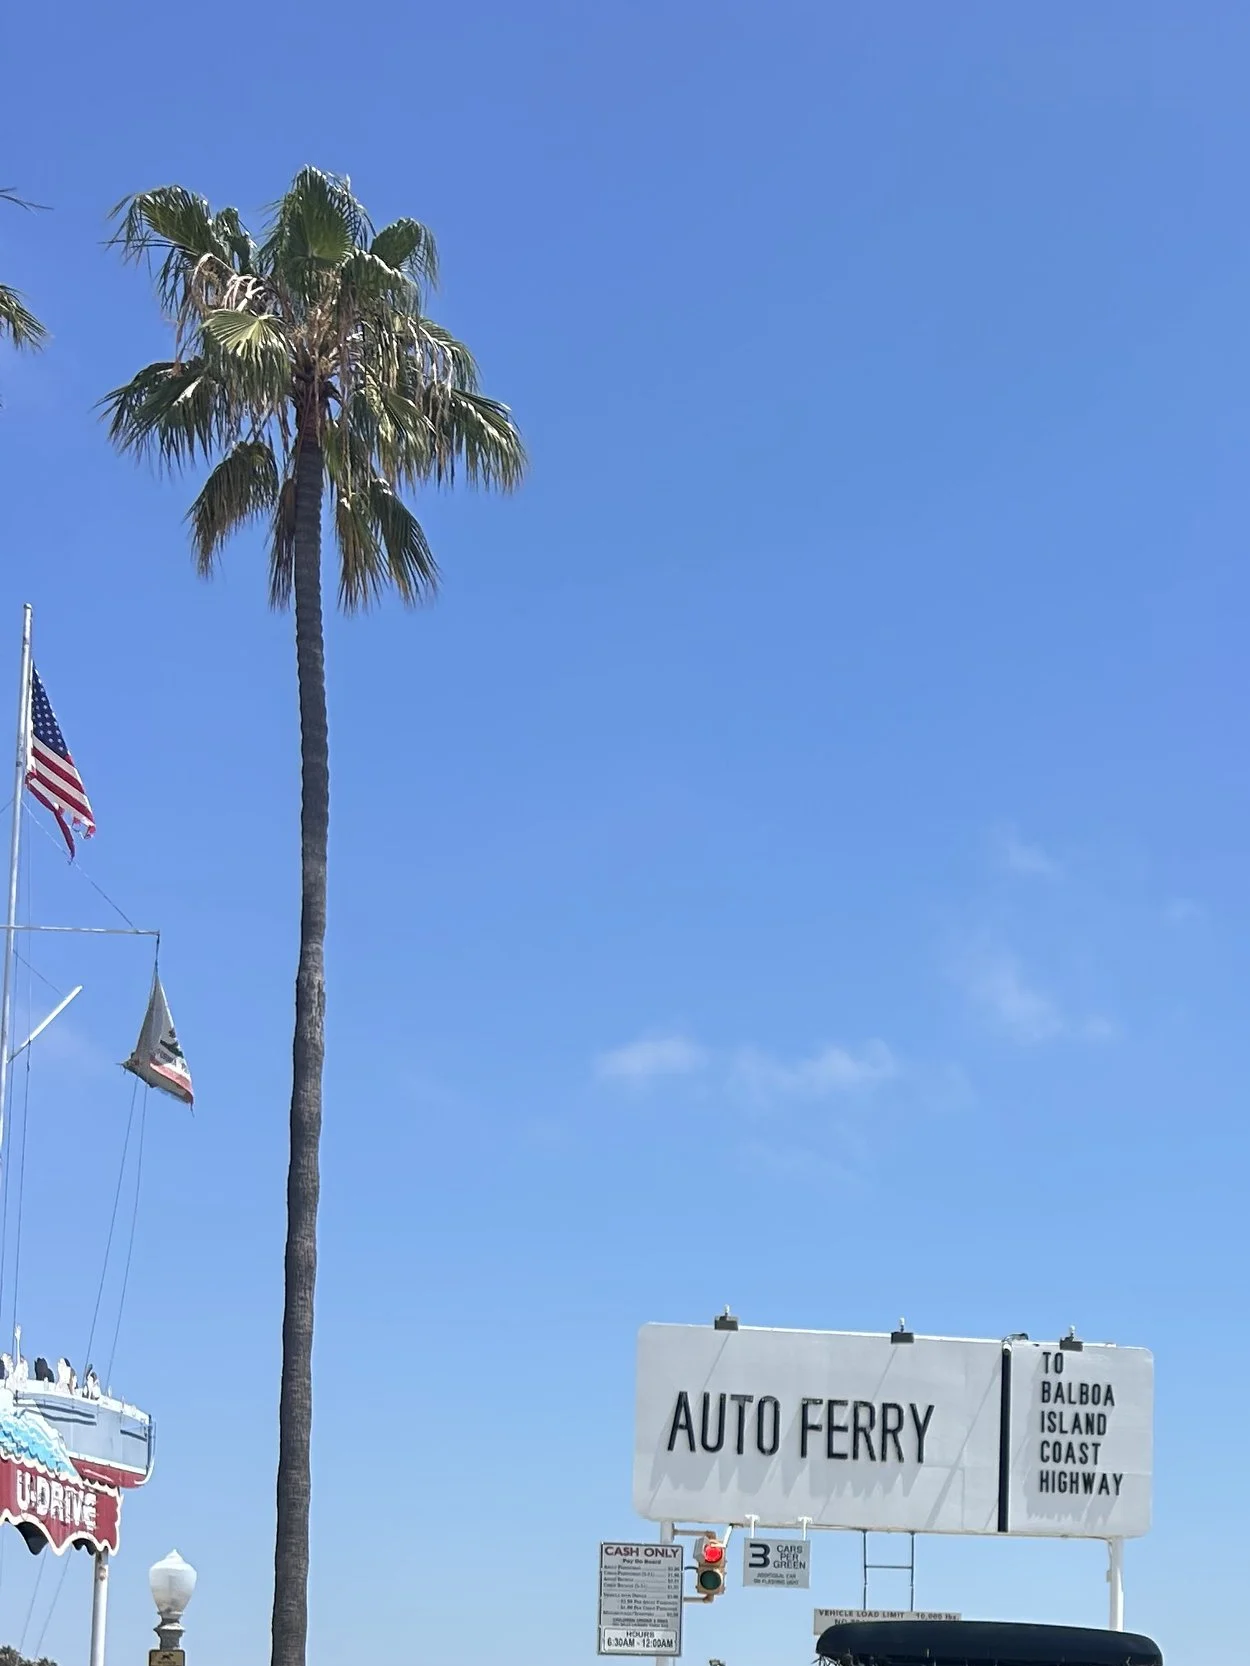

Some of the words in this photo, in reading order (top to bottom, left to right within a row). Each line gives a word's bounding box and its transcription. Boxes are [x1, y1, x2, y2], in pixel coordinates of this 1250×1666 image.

[1042, 1352, 1064, 1374] TO
[1041, 1381, 1115, 1406] BALBOA
[667, 1391, 781, 1456] AUTO
[800, 1397, 935, 1463] FERRY
[1040, 1411, 1107, 1436] ISLAND
[1040, 1440, 1101, 1465] COAST
[1039, 1470, 1123, 1496] HIGHWAY
[604, 1546, 640, 1557] CASH
[644, 1547, 680, 1558] ONLY
[748, 1542, 771, 1569] 3
[776, 1544, 803, 1554] CARS
[780, 1553, 799, 1561] PER
[773, 1560, 806, 1570] GREEN
[819, 1609, 854, 1617] VEHICLE
[856, 1610, 880, 1618] LOAD
[882, 1611, 905, 1619] LIMIT
